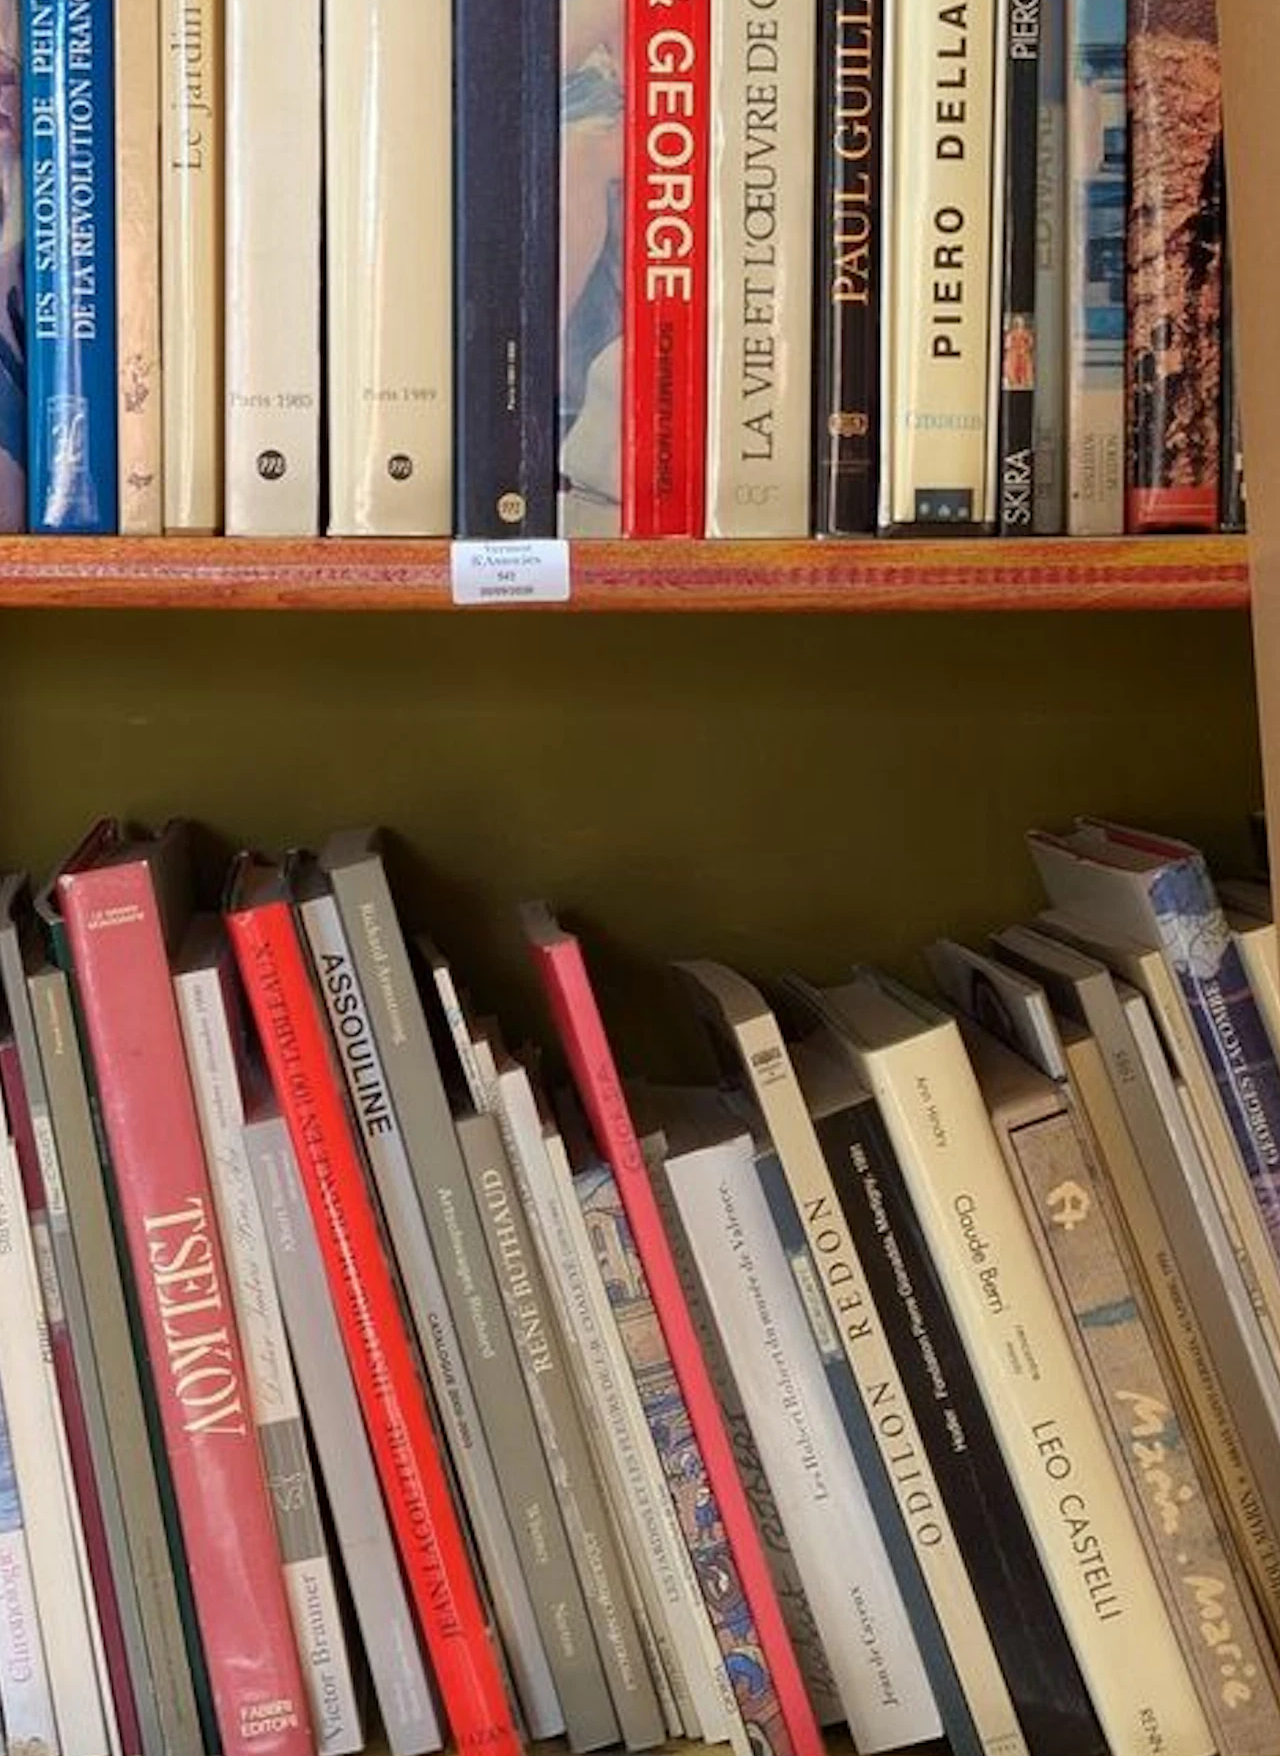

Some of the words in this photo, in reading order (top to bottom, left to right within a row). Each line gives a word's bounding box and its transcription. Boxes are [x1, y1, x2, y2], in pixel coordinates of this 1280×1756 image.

[934, 1, 970, 163] DELLA
[33, 157, 57, 271] SALONS
[645, 30, 696, 303] GEORGE
[832, 165, 874, 307] PAUL
[931, 204, 967, 360] PIERO
[742, 336, 775, 398] VIE
[1003, 448, 1031, 526] SKIRA
[322, 952, 394, 1139] ASSOULINE
[144, 1194, 247, 1439] TSELKOV
[804, 1196, 873, 1342] REDON
[864, 1379, 944, 1549] ODILON
[1033, 1420, 1072, 1482] LEO
[1058, 1495, 1124, 1622] CASTELLI
[1138, 1706, 1164, 1756] RENN
